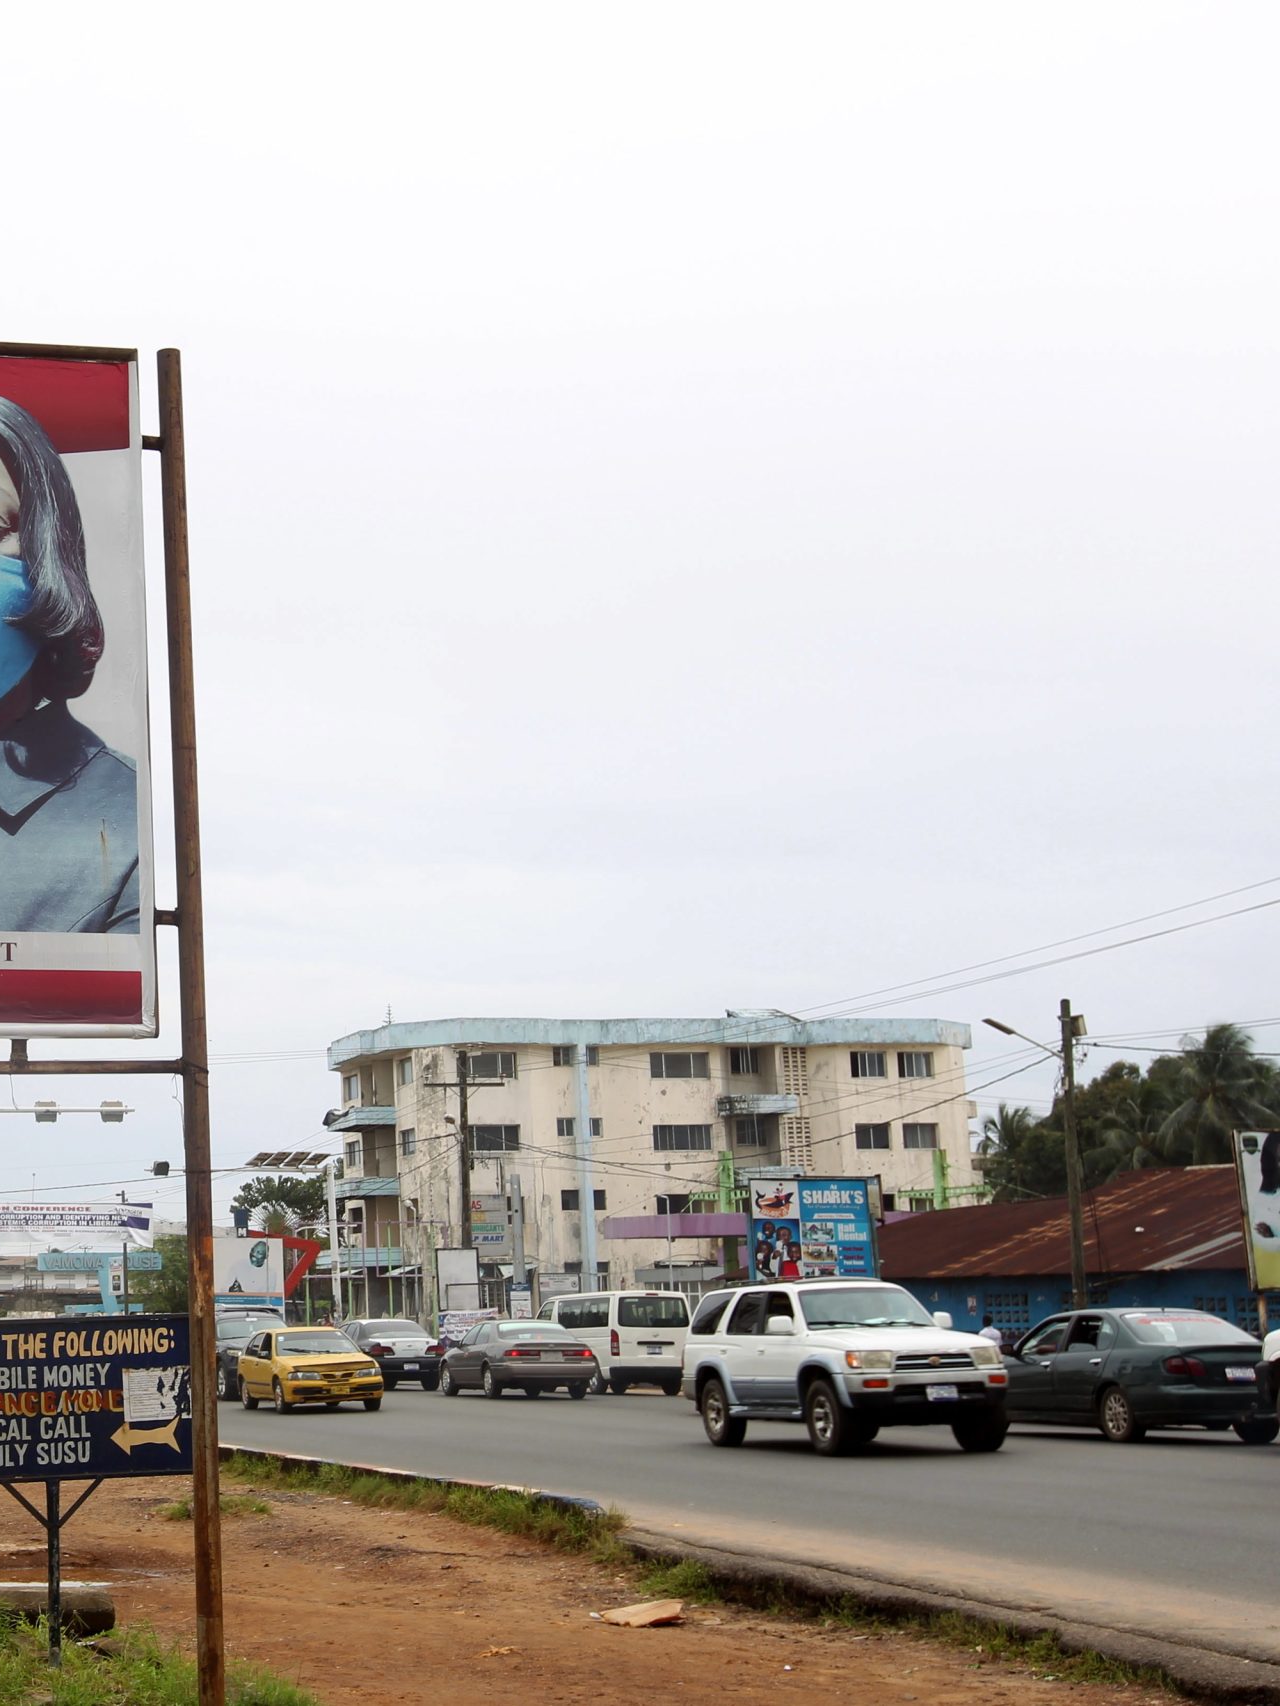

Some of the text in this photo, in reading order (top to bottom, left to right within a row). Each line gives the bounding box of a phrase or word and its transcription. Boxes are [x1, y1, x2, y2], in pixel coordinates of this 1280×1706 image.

[471, 1200, 482, 1210] AS
[802, 1190, 864, 1204] SHARK'S
[43, 1256, 158, 1269] VAMOMA OUSE
[2, 1332, 47, 1360] THE
[53, 1327, 175, 1358] FOLLOWING:
[43, 1362, 111, 1388] MONEY
[40, 1415, 91, 1440] CALL
[36, 1440, 91, 1465] SUSU
